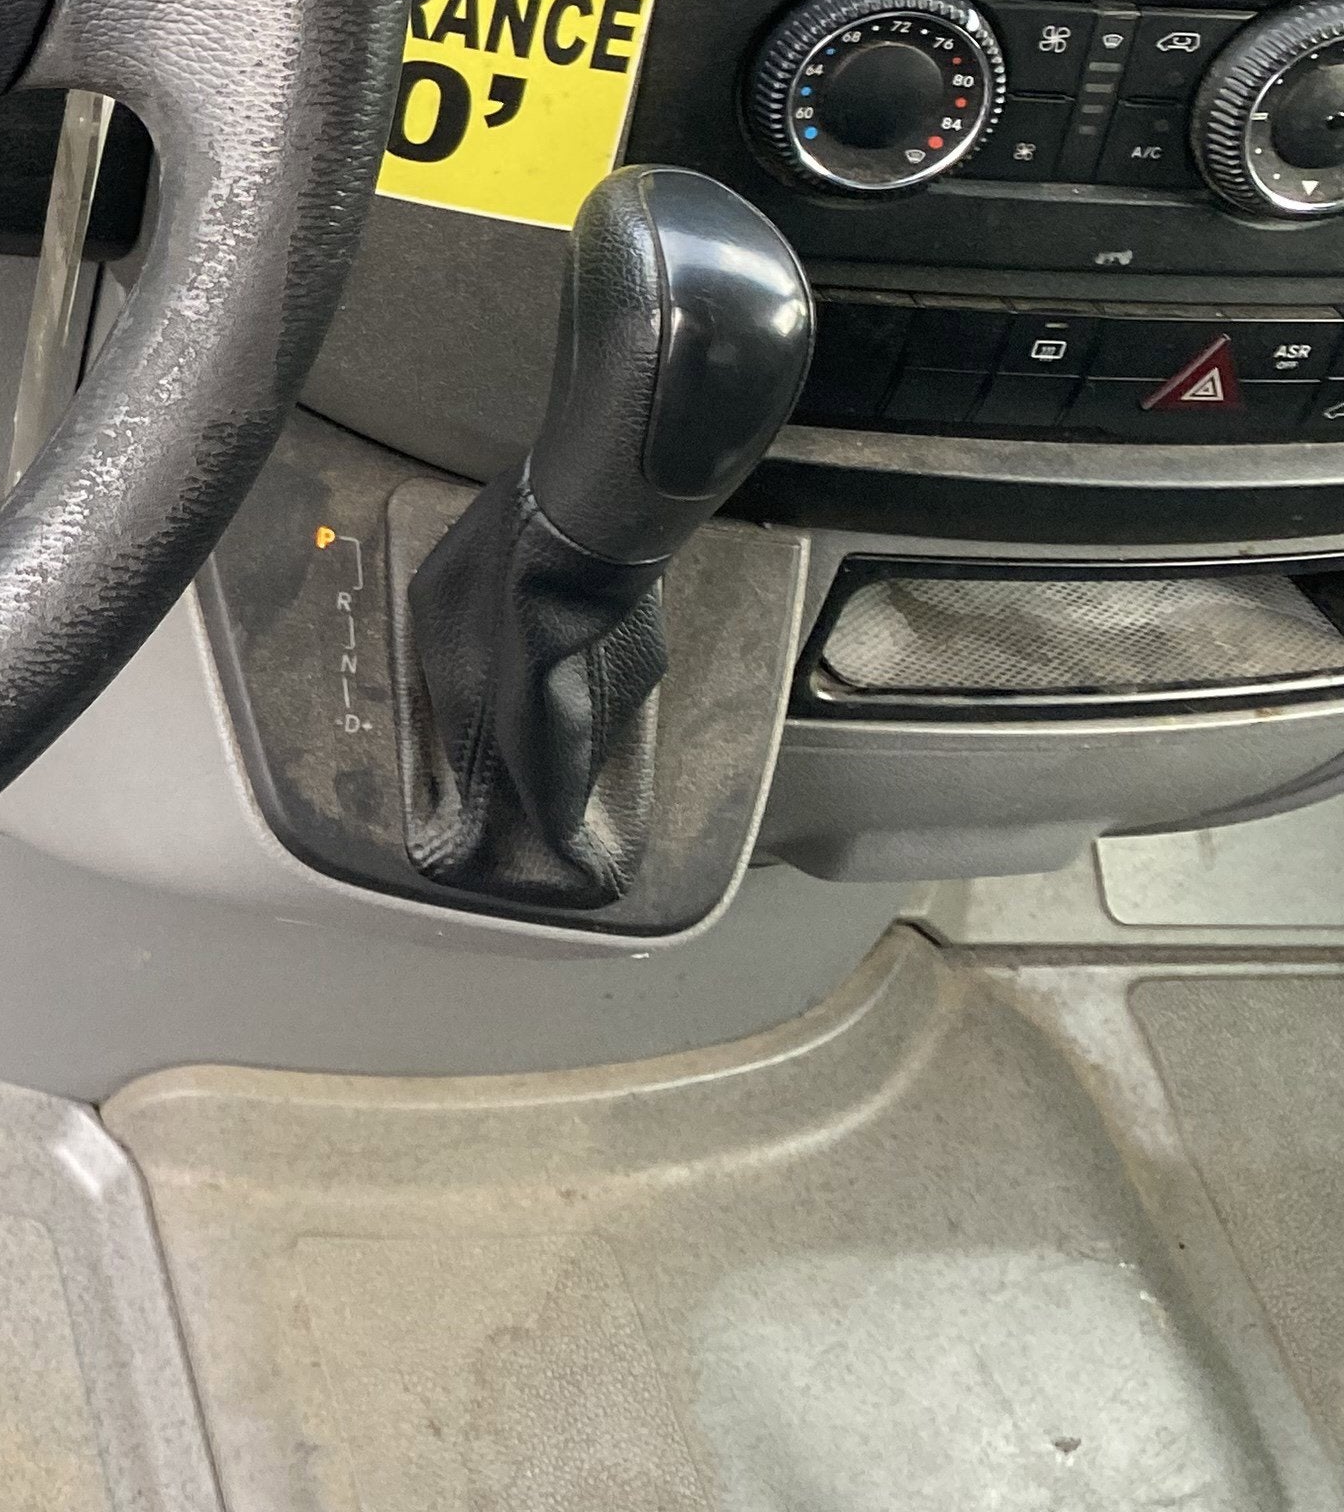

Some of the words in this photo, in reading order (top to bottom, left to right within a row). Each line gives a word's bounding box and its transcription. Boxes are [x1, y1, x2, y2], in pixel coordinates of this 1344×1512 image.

[889, 20, 913, 34] 72
[842, 31, 862, 43] 68
[932, 37, 955, 50] 76
[805, 64, 824, 76] 64
[952, 75, 975, 88] 80
[795, 106, 814, 119] 60
[941, 117, 963, 131] 84
[1130, 144, 1162, 162] A/C
[1273, 344, 1312, 359] ASR
[315, 525, 336, 549] P
[336, 591, 353, 612] R
[340, 654, 358, 674] N
